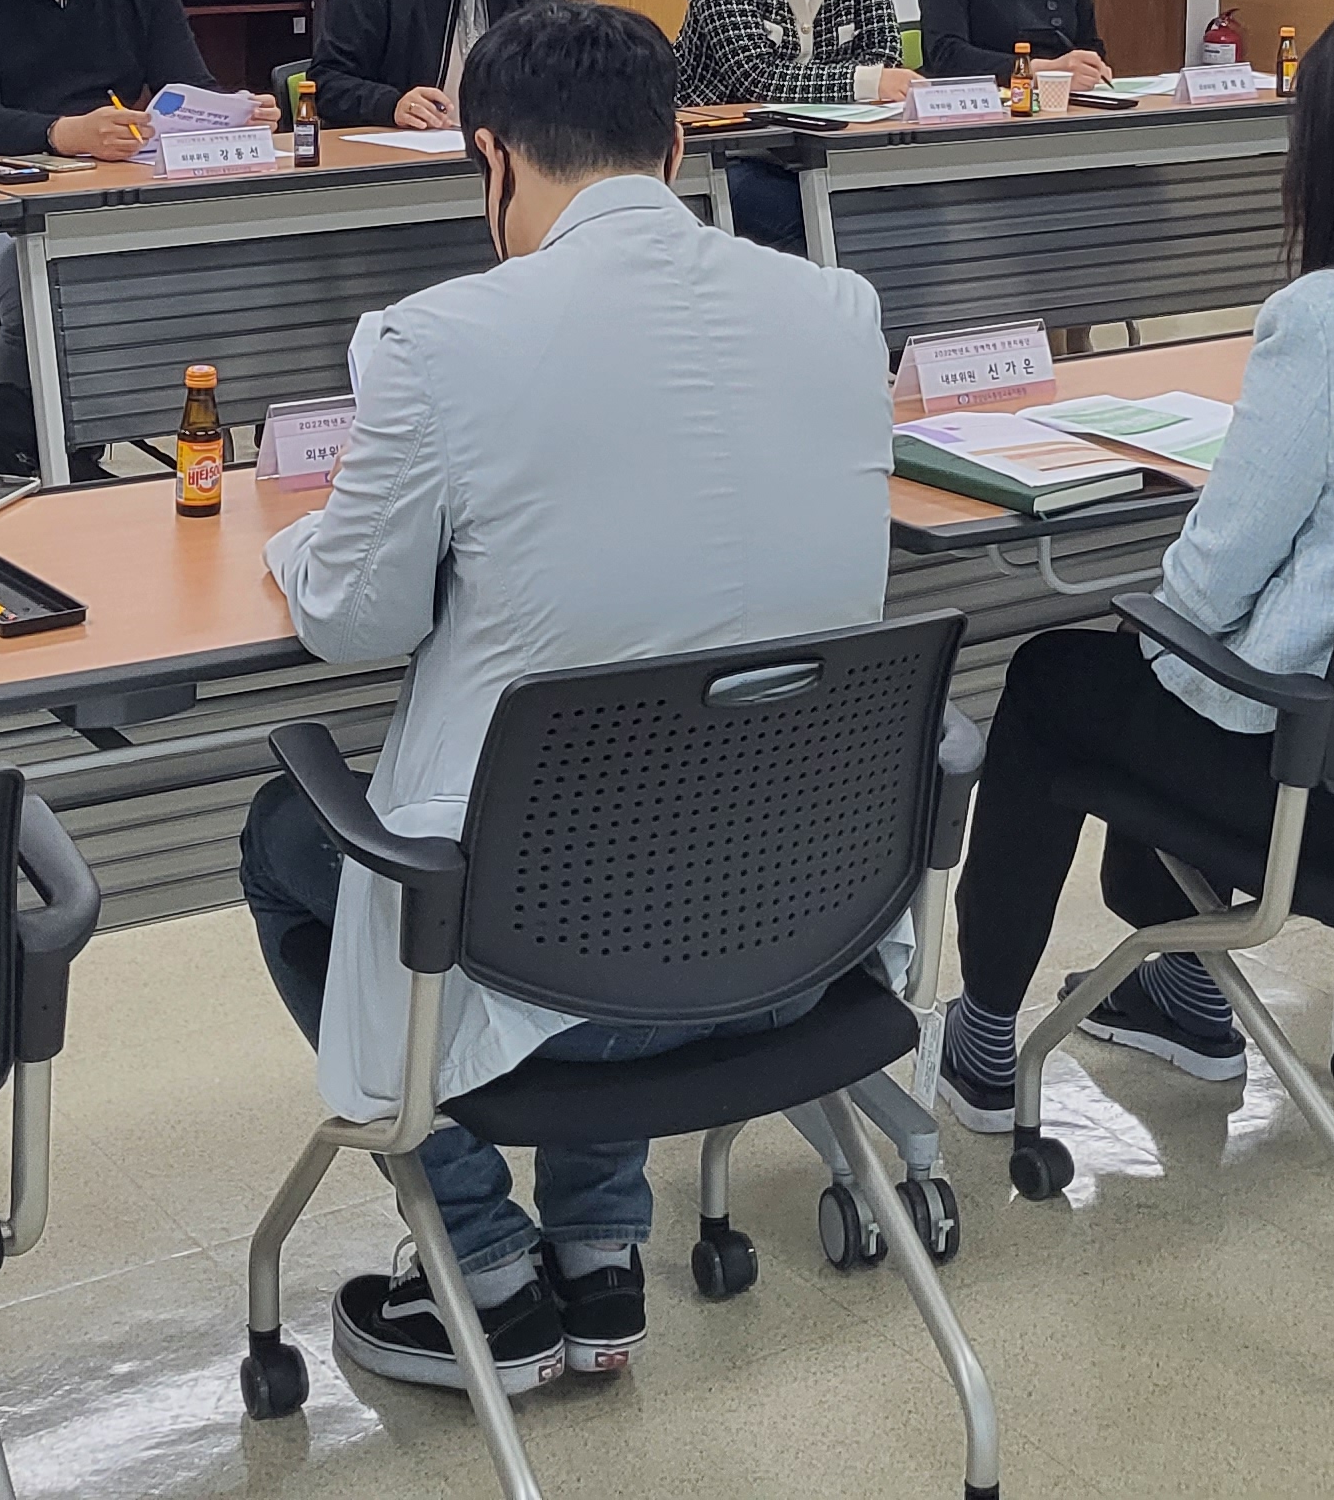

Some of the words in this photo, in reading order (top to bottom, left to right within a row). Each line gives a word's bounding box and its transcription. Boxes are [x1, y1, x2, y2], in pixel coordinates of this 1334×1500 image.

[181, 152, 210, 163] 외부위원
[219, 145, 260, 162] 강동선
[940, 370, 977, 385] 내부위원
[987, 357, 1035, 381] 신가은
[298, 417, 347, 431] 2022학년도
[305, 444, 344, 461] 외부위
